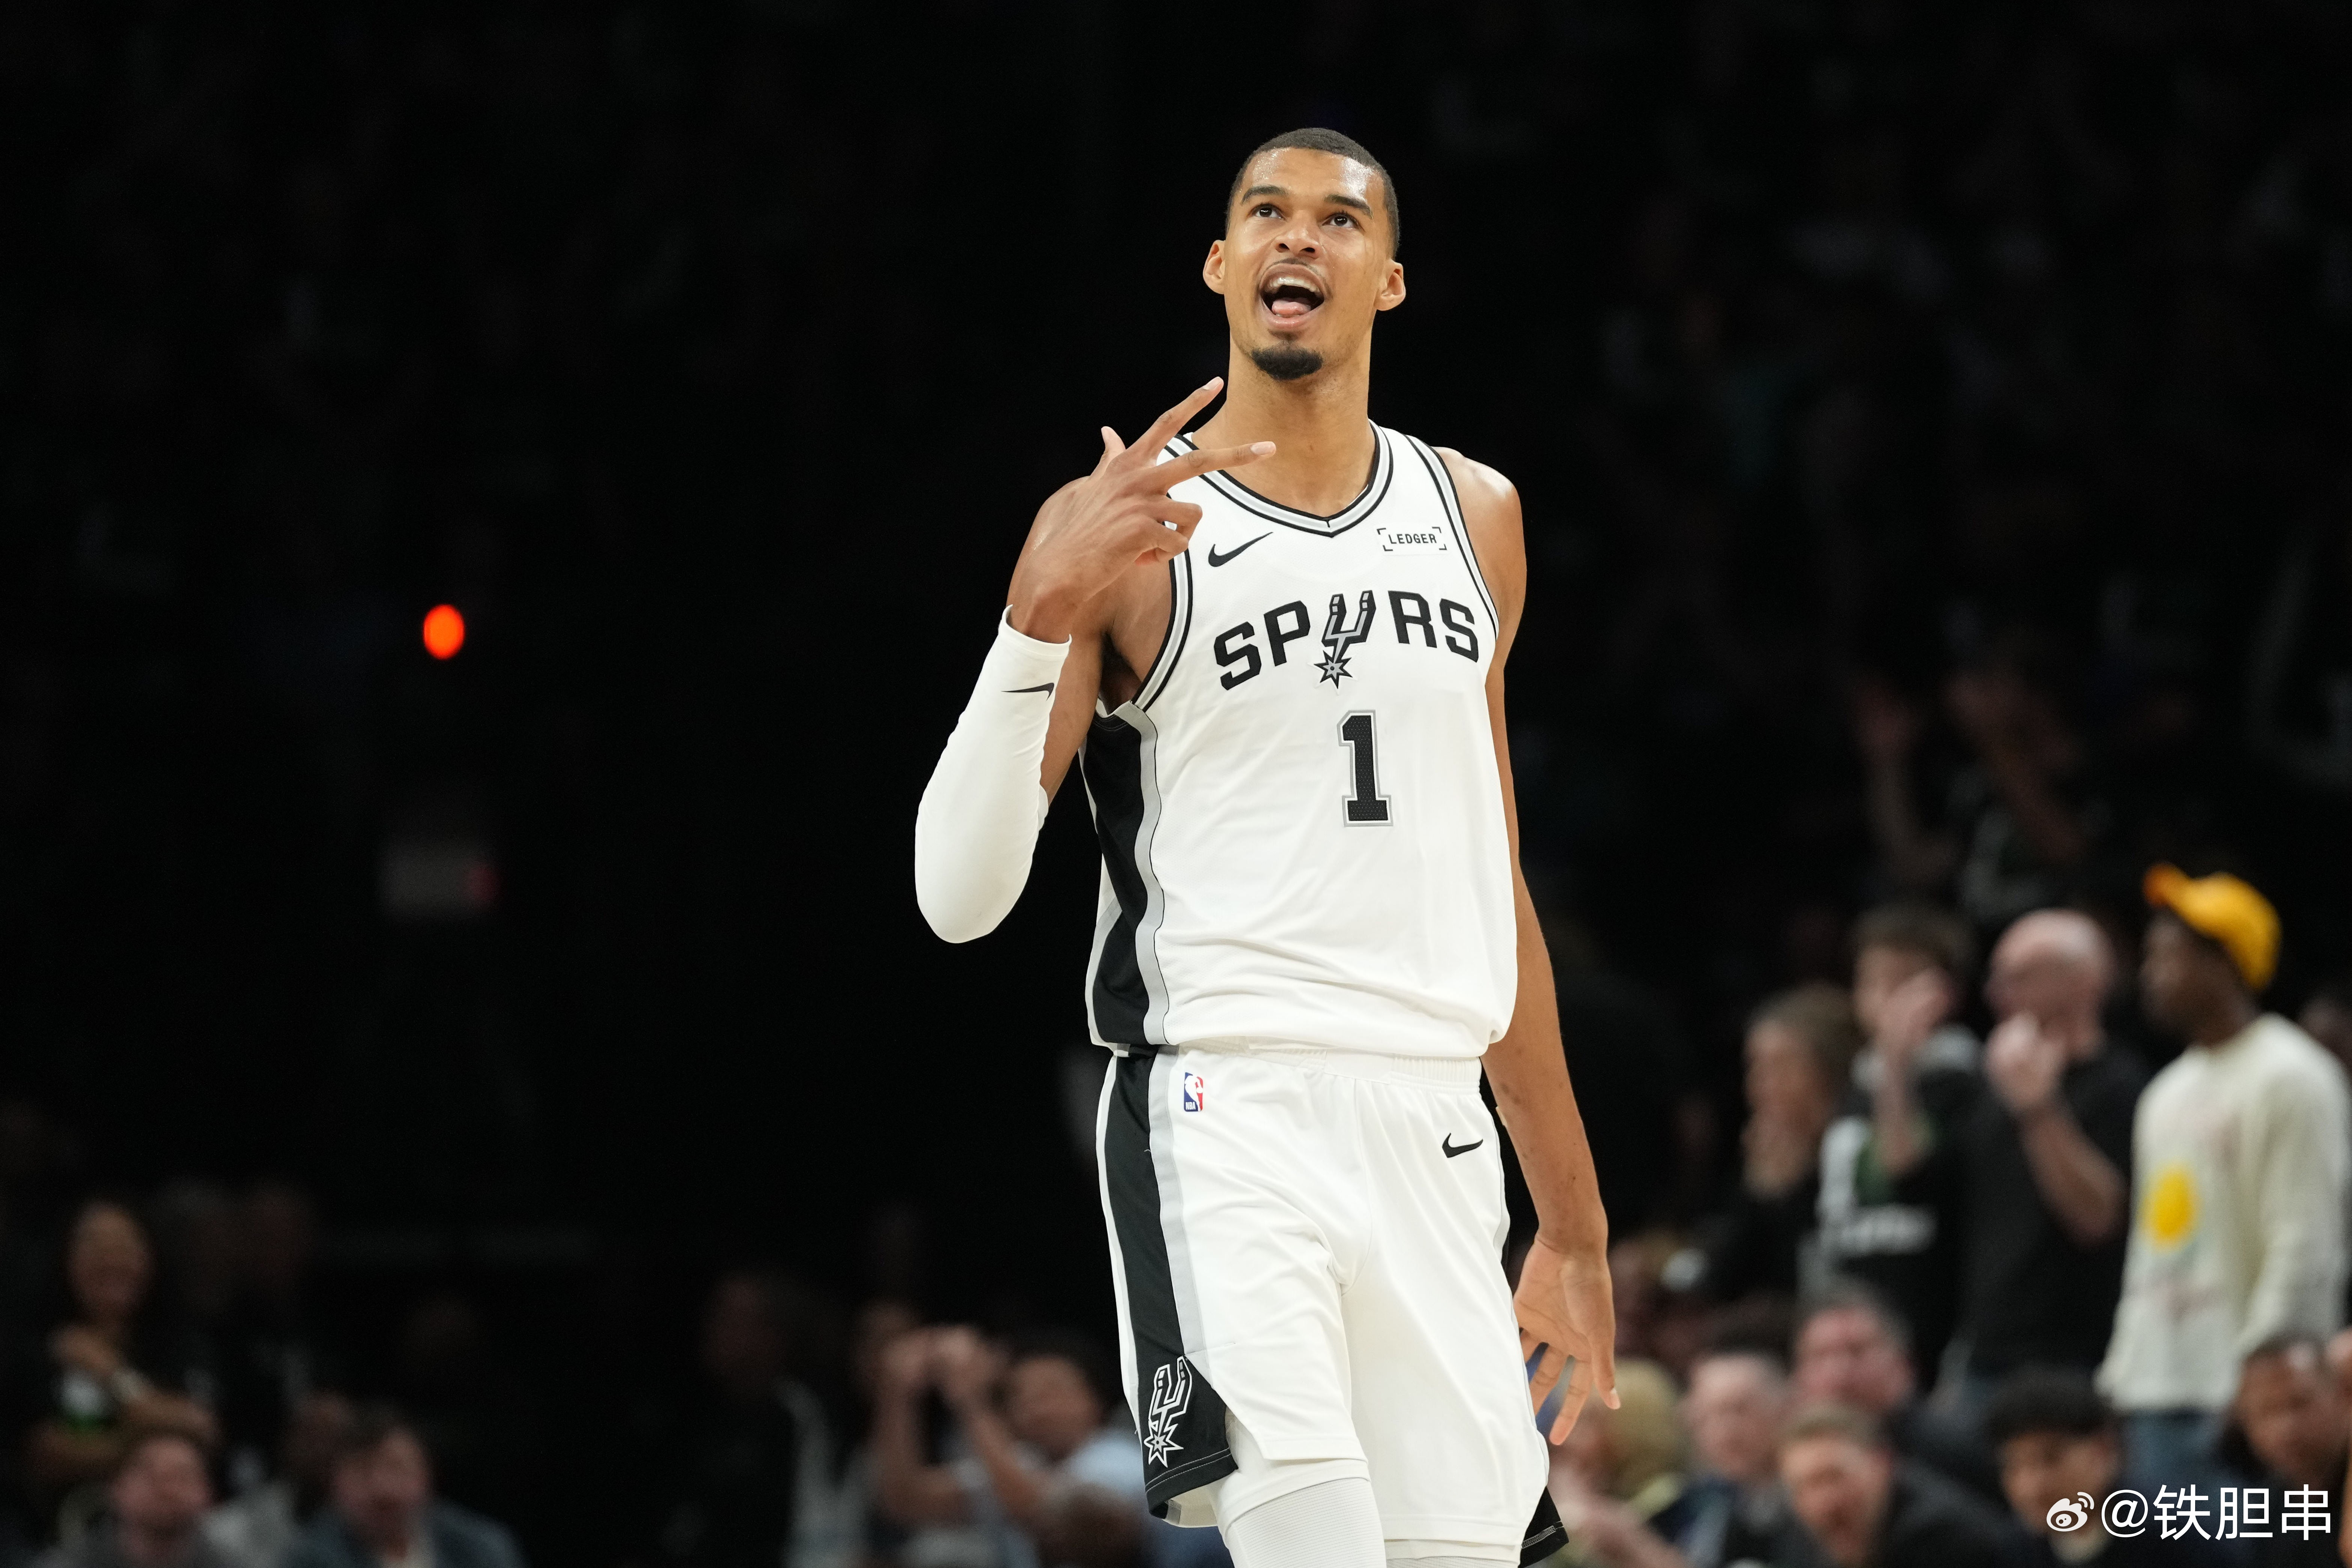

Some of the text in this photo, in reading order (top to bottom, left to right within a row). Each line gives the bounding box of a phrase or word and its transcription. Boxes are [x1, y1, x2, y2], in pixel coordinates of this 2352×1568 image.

[1388, 534, 1437, 544] LEDGER
[1213, 590, 1479, 690] SPURS
[1337, 710, 1393, 827] 1
[1185, 1102, 1196, 1110] NBA
